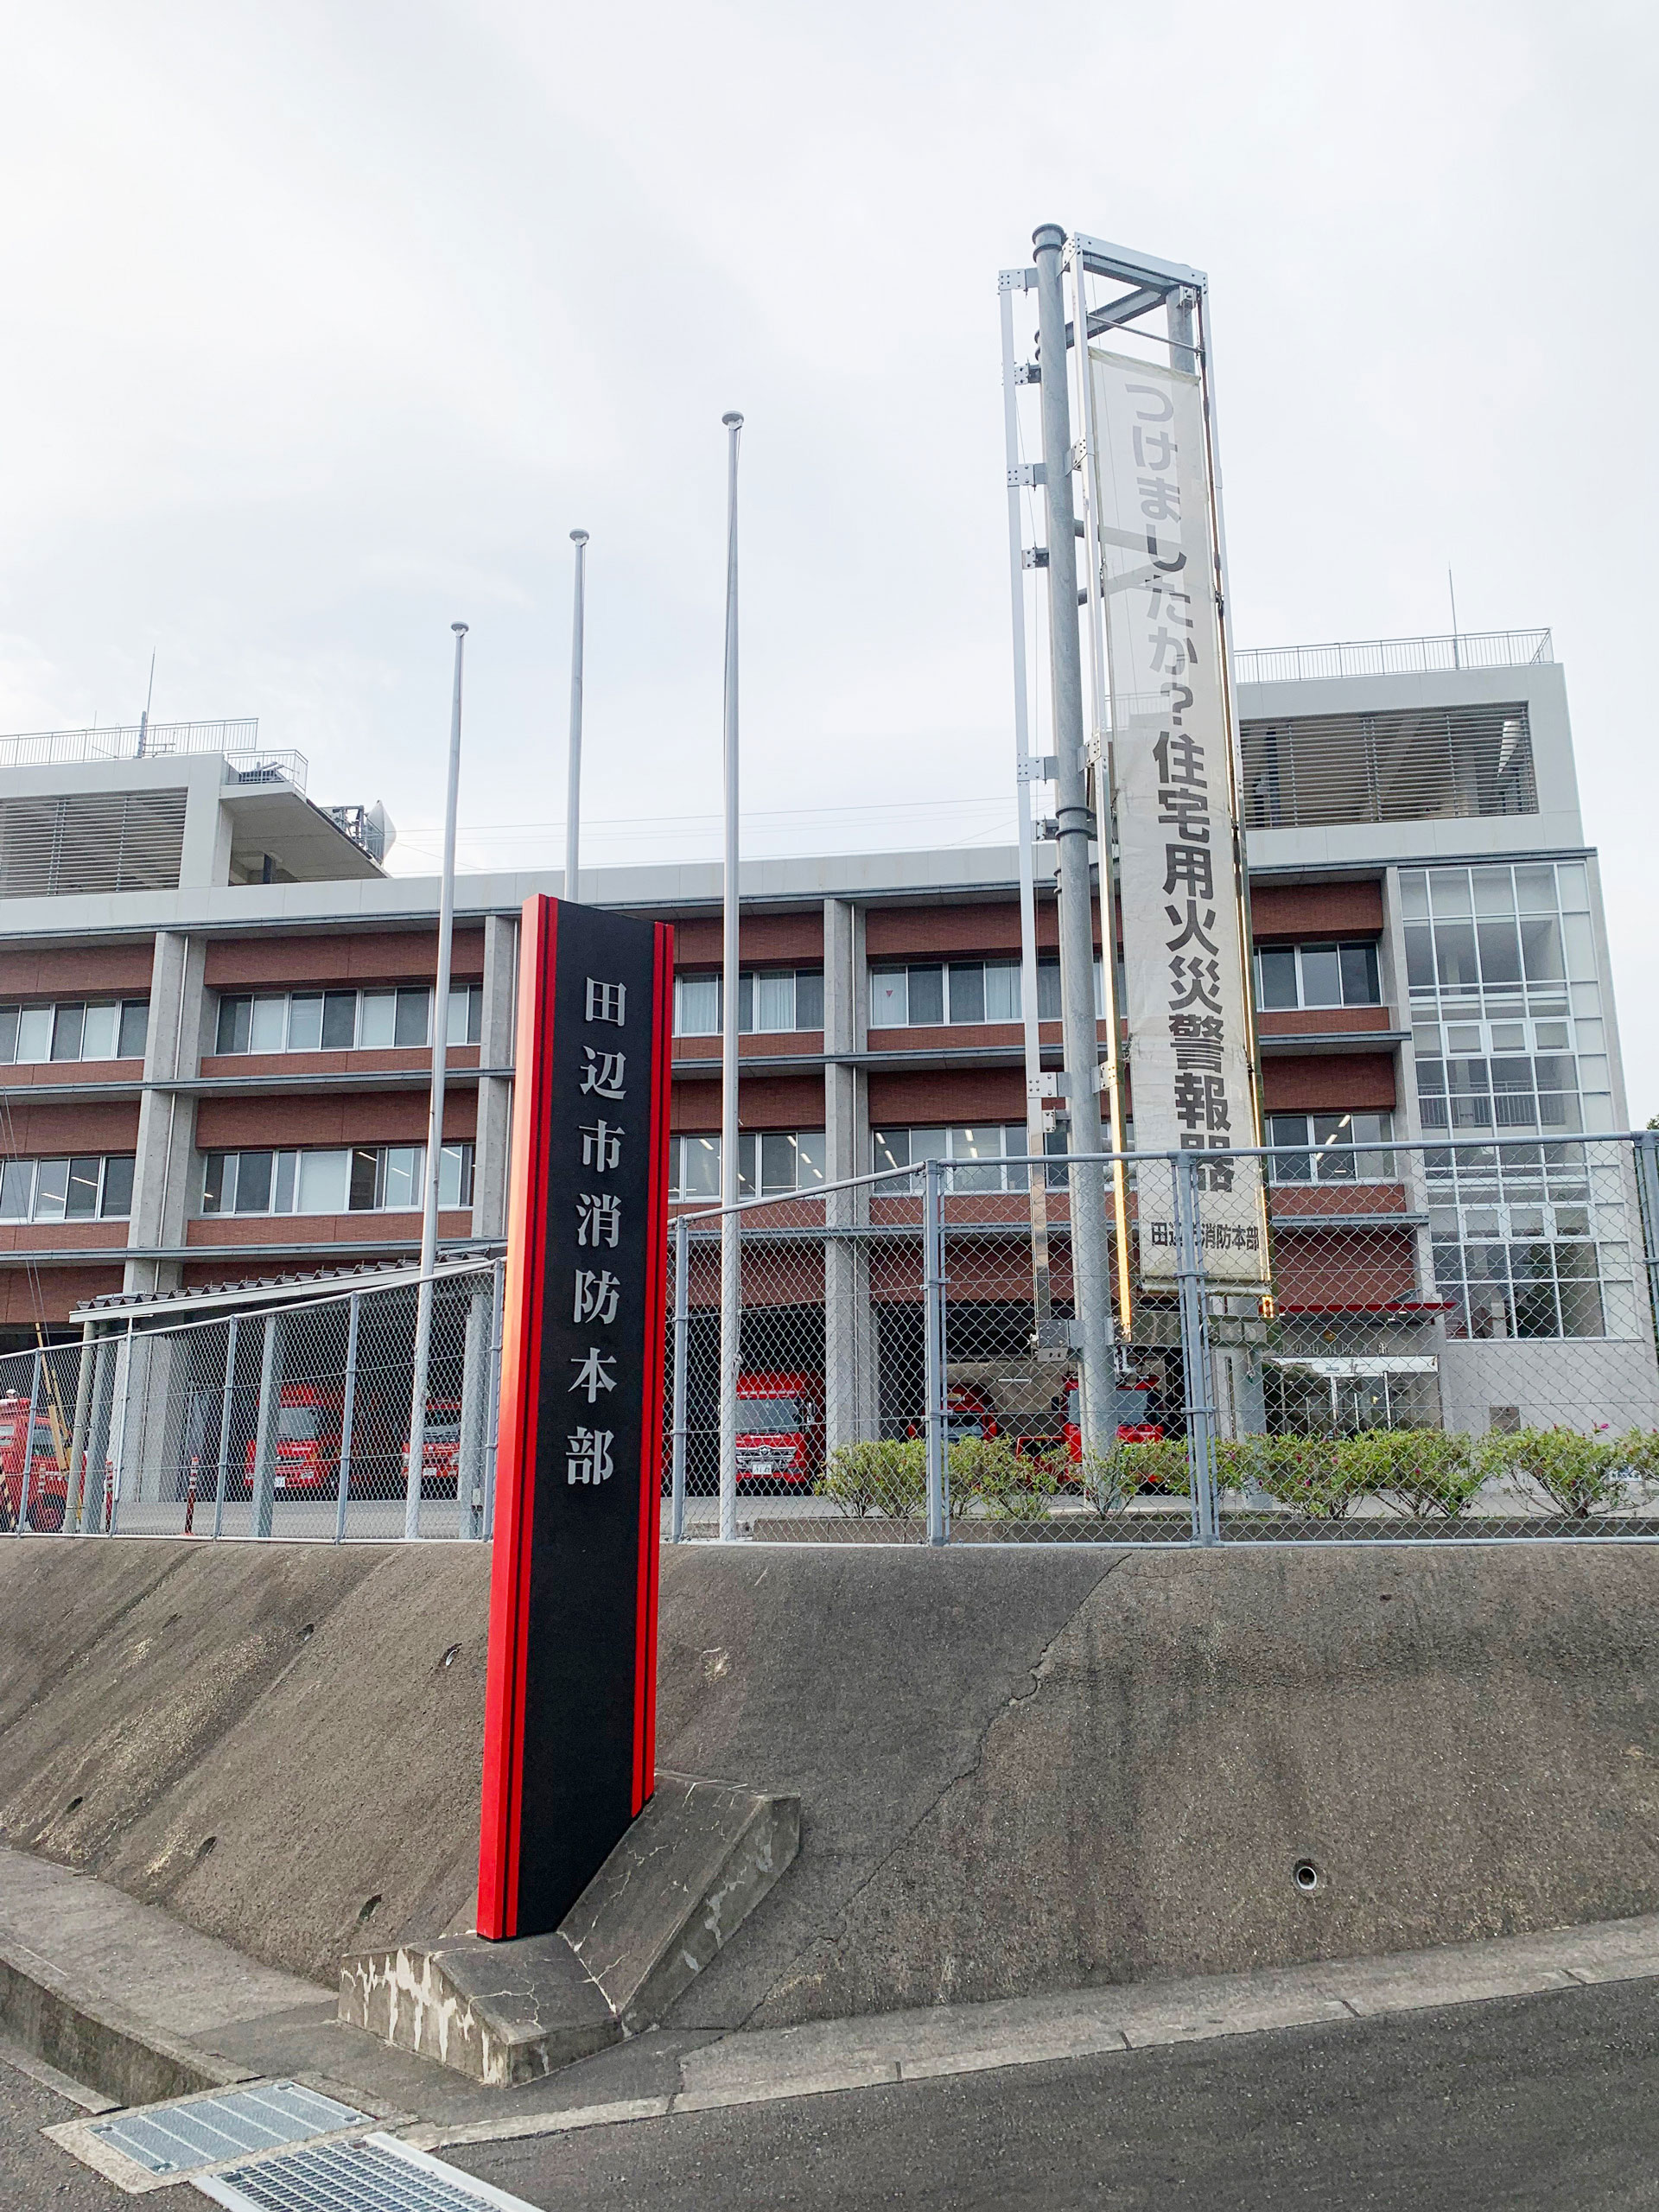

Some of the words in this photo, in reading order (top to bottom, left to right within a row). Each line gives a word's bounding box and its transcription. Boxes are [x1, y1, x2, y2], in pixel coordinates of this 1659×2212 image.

[565, 976, 626, 1484] 田辺市消防本部
[1151, 1222, 1259, 1251] 田消防本部
